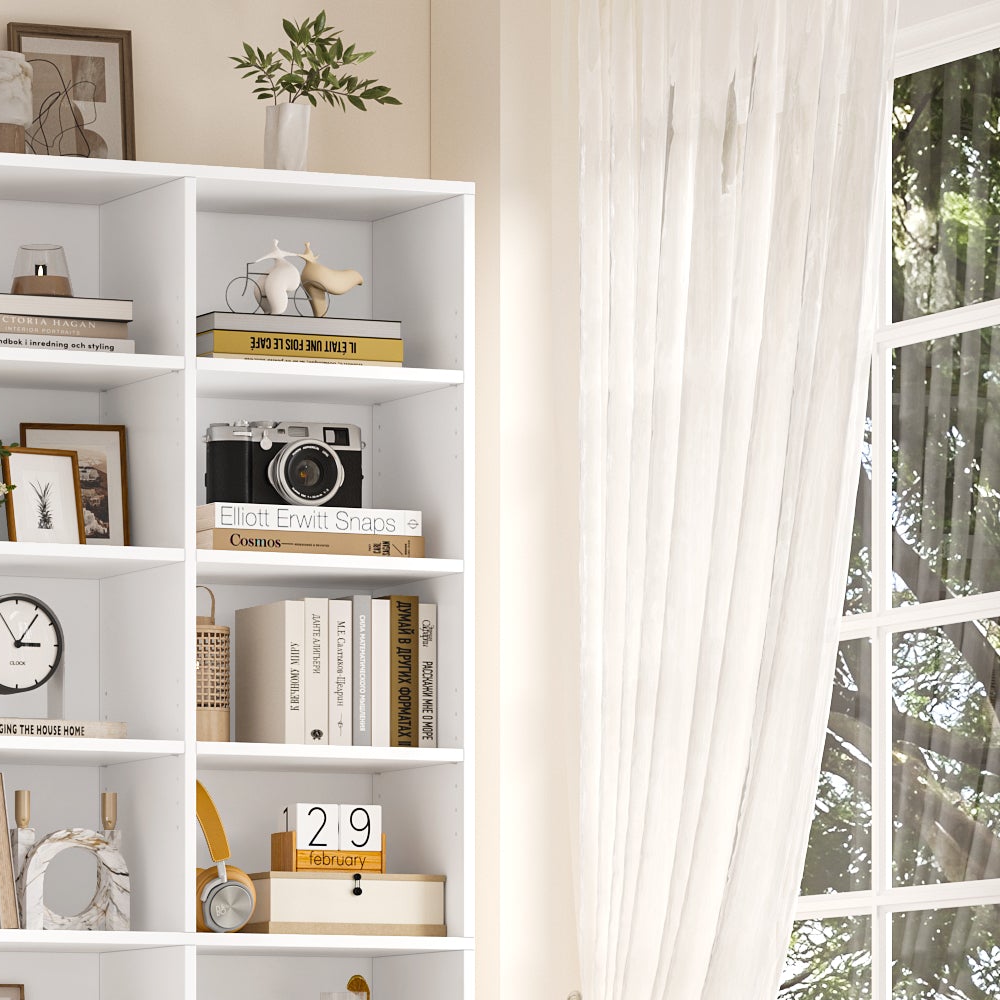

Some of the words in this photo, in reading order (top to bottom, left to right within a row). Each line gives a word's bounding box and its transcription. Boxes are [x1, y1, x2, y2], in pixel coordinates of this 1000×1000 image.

[53, 320, 96, 329] HAGAN
[29, 338, 68, 349] inredning
[71, 341, 86, 349] och
[88, 342, 115, 352] styling
[250, 336, 272, 351] CAFÉ
[273, 338, 283, 350] LE
[286, 338, 303, 351] FOIS
[305, 340, 322, 352] UNE
[325, 340, 347, 355] ÉTAIT
[350, 341, 357, 354] IL
[220, 506, 270, 527] Elliott
[277, 508, 329, 530] Erwitt
[336, 511, 396, 535] Snaps
[229, 533, 281, 549] Cosmos
[312, 613, 321, 637] ДАНТЕ
[396, 600, 415, 636] ДУМАЙ
[312, 637, 321, 674] АЛИГЬЕРИ
[396, 646, 412, 684] ДРУГИХ
[422, 661, 434, 701] РАССКАЖИ
[397, 686, 412, 738] ФОРМАТАХ
[422, 702, 434, 713] МНЕ
[20, 724, 34, 735] THE
[36, 725, 61, 736] HOUSE
[63, 726, 85, 737] HOME
[422, 721, 434, 741] МОРЕ
[309, 850, 366, 870] february
